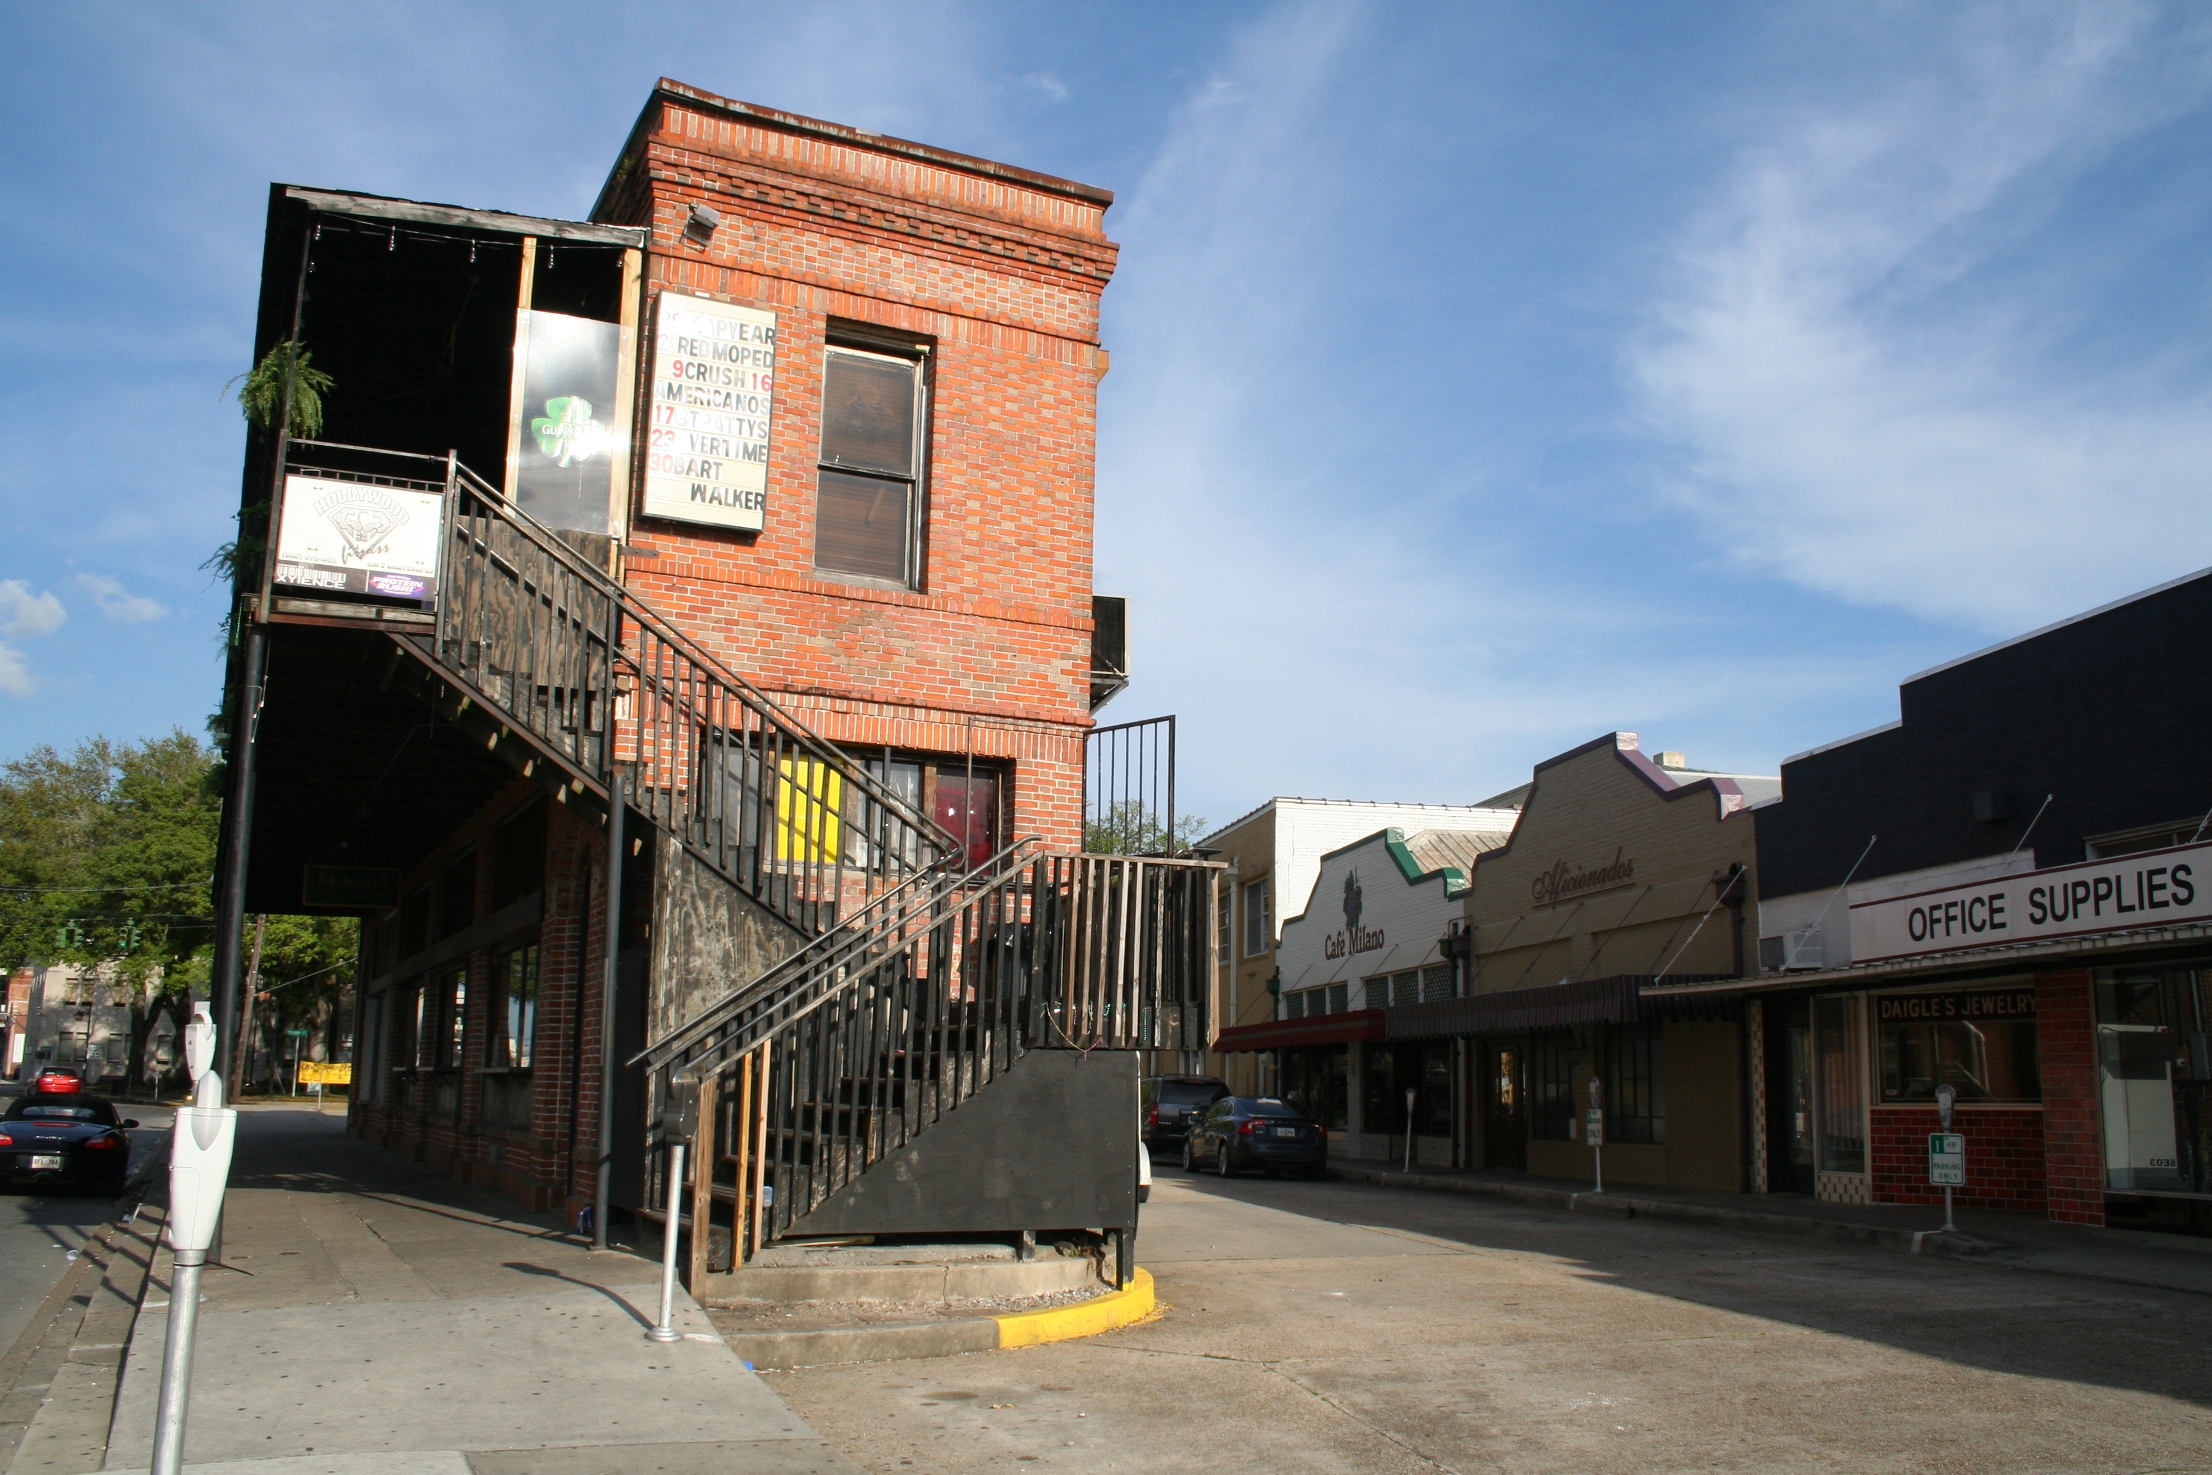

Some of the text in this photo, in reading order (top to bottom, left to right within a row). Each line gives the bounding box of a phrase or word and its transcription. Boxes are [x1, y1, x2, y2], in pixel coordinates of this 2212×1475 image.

[752, 372, 773, 392] 16
[655, 379, 771, 416] AMERICANOS
[656, 404, 675, 425] 17
[313, 486, 411, 525] HOLLYWOOD
[690, 482, 765, 512] WALKER
[277, 573, 346, 590] XYIENCE
[373, 576, 424, 588] PROTEIN
[1532, 846, 1634, 910] Aficionados
[1908, 864, 2194, 942] OFFICE SUPPLIES
[1325, 924, 1385, 961] Café Milano
[1881, 993, 2037, 1019] DAIGLE'S JEWELRY
[1946, 1141, 1956, 1149] HR
[1933, 1163, 1961, 1171] PARKING
[1938, 1172, 1958, 1180] ONLY
